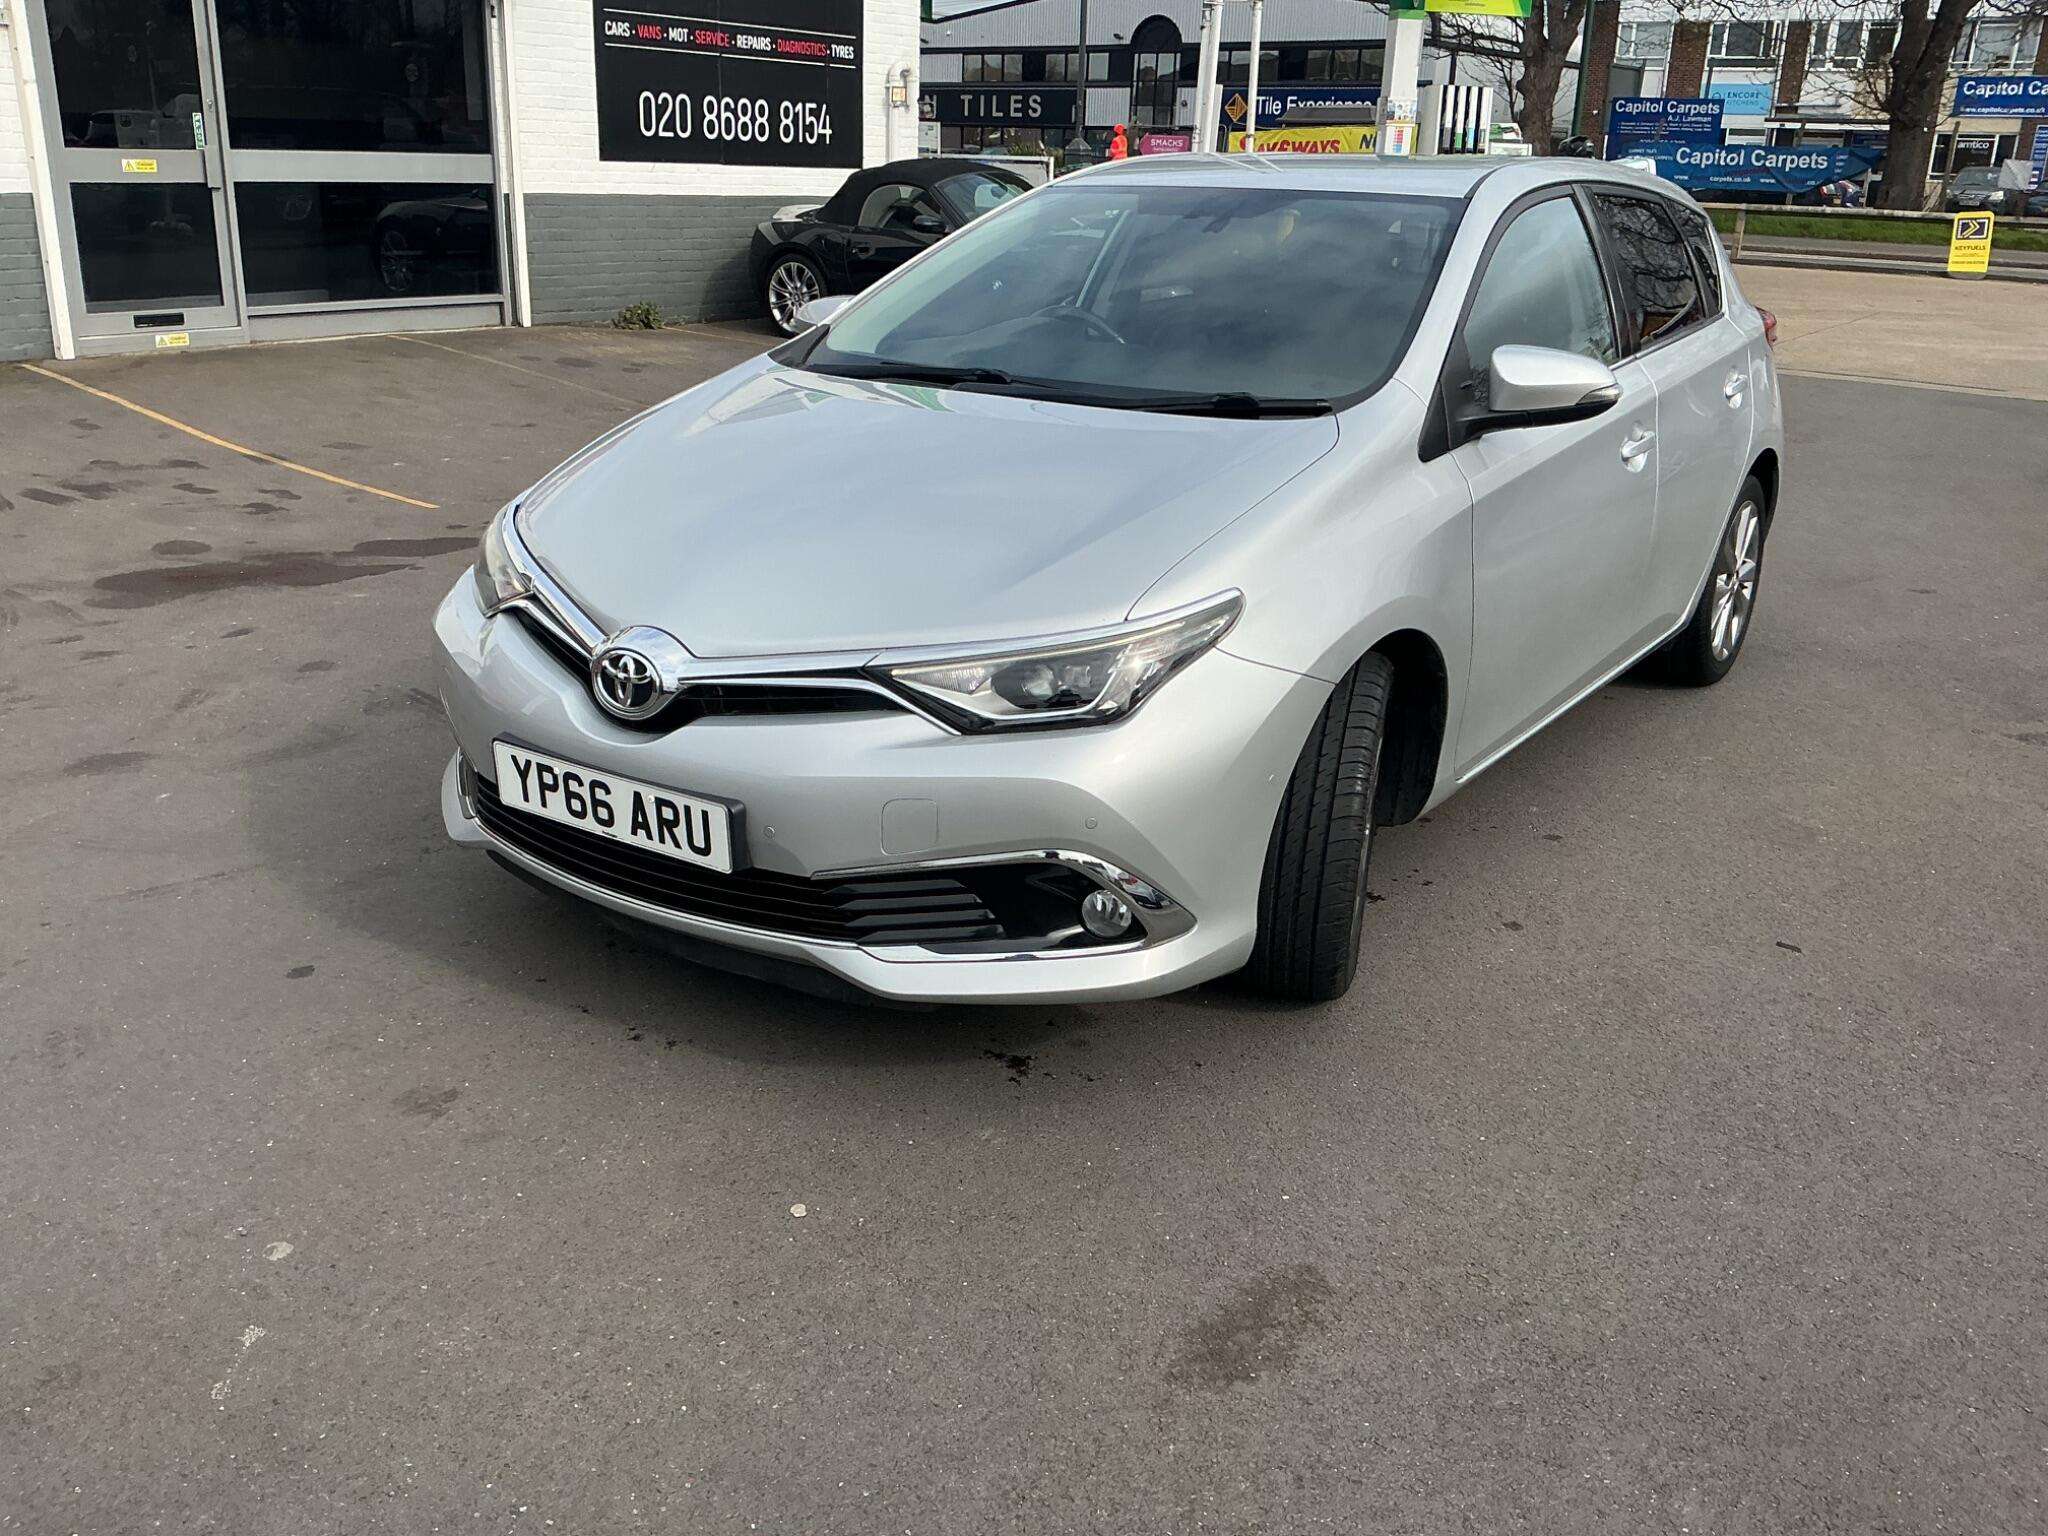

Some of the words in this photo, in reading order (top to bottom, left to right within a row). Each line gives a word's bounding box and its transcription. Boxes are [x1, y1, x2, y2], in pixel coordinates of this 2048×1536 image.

[605, 21, 631, 38] CARS
[637, 24, 662, 40] VANS
[668, 27, 688, 43] MOT
[695, 29, 730, 47] SERVICE
[736, 34, 772, 51] REPAIRS
[777, 39, 826, 56] DIAGNOSTICS
[831, 44, 854, 60] TYRES
[1727, 91, 1759, 99] ENCORE
[1963, 80, 2024, 98] Capitol
[960, 94, 1042, 118] TILES
[1256, 96, 1282, 115] Tile
[1615, 100, 1662, 115] Capitol
[1667, 101, 1720, 116] Carpets
[639, 91, 692, 139] 020
[703, 95, 769, 142] 8688
[779, 101, 833, 144] 8154
[1150, 138, 1184, 147] SMACKS
[1675, 147, 1745, 168] Capitol
[1751, 149, 1828, 171] Carpets
[510, 754, 615, 828] YP66
[630, 790, 712, 857] ARU
